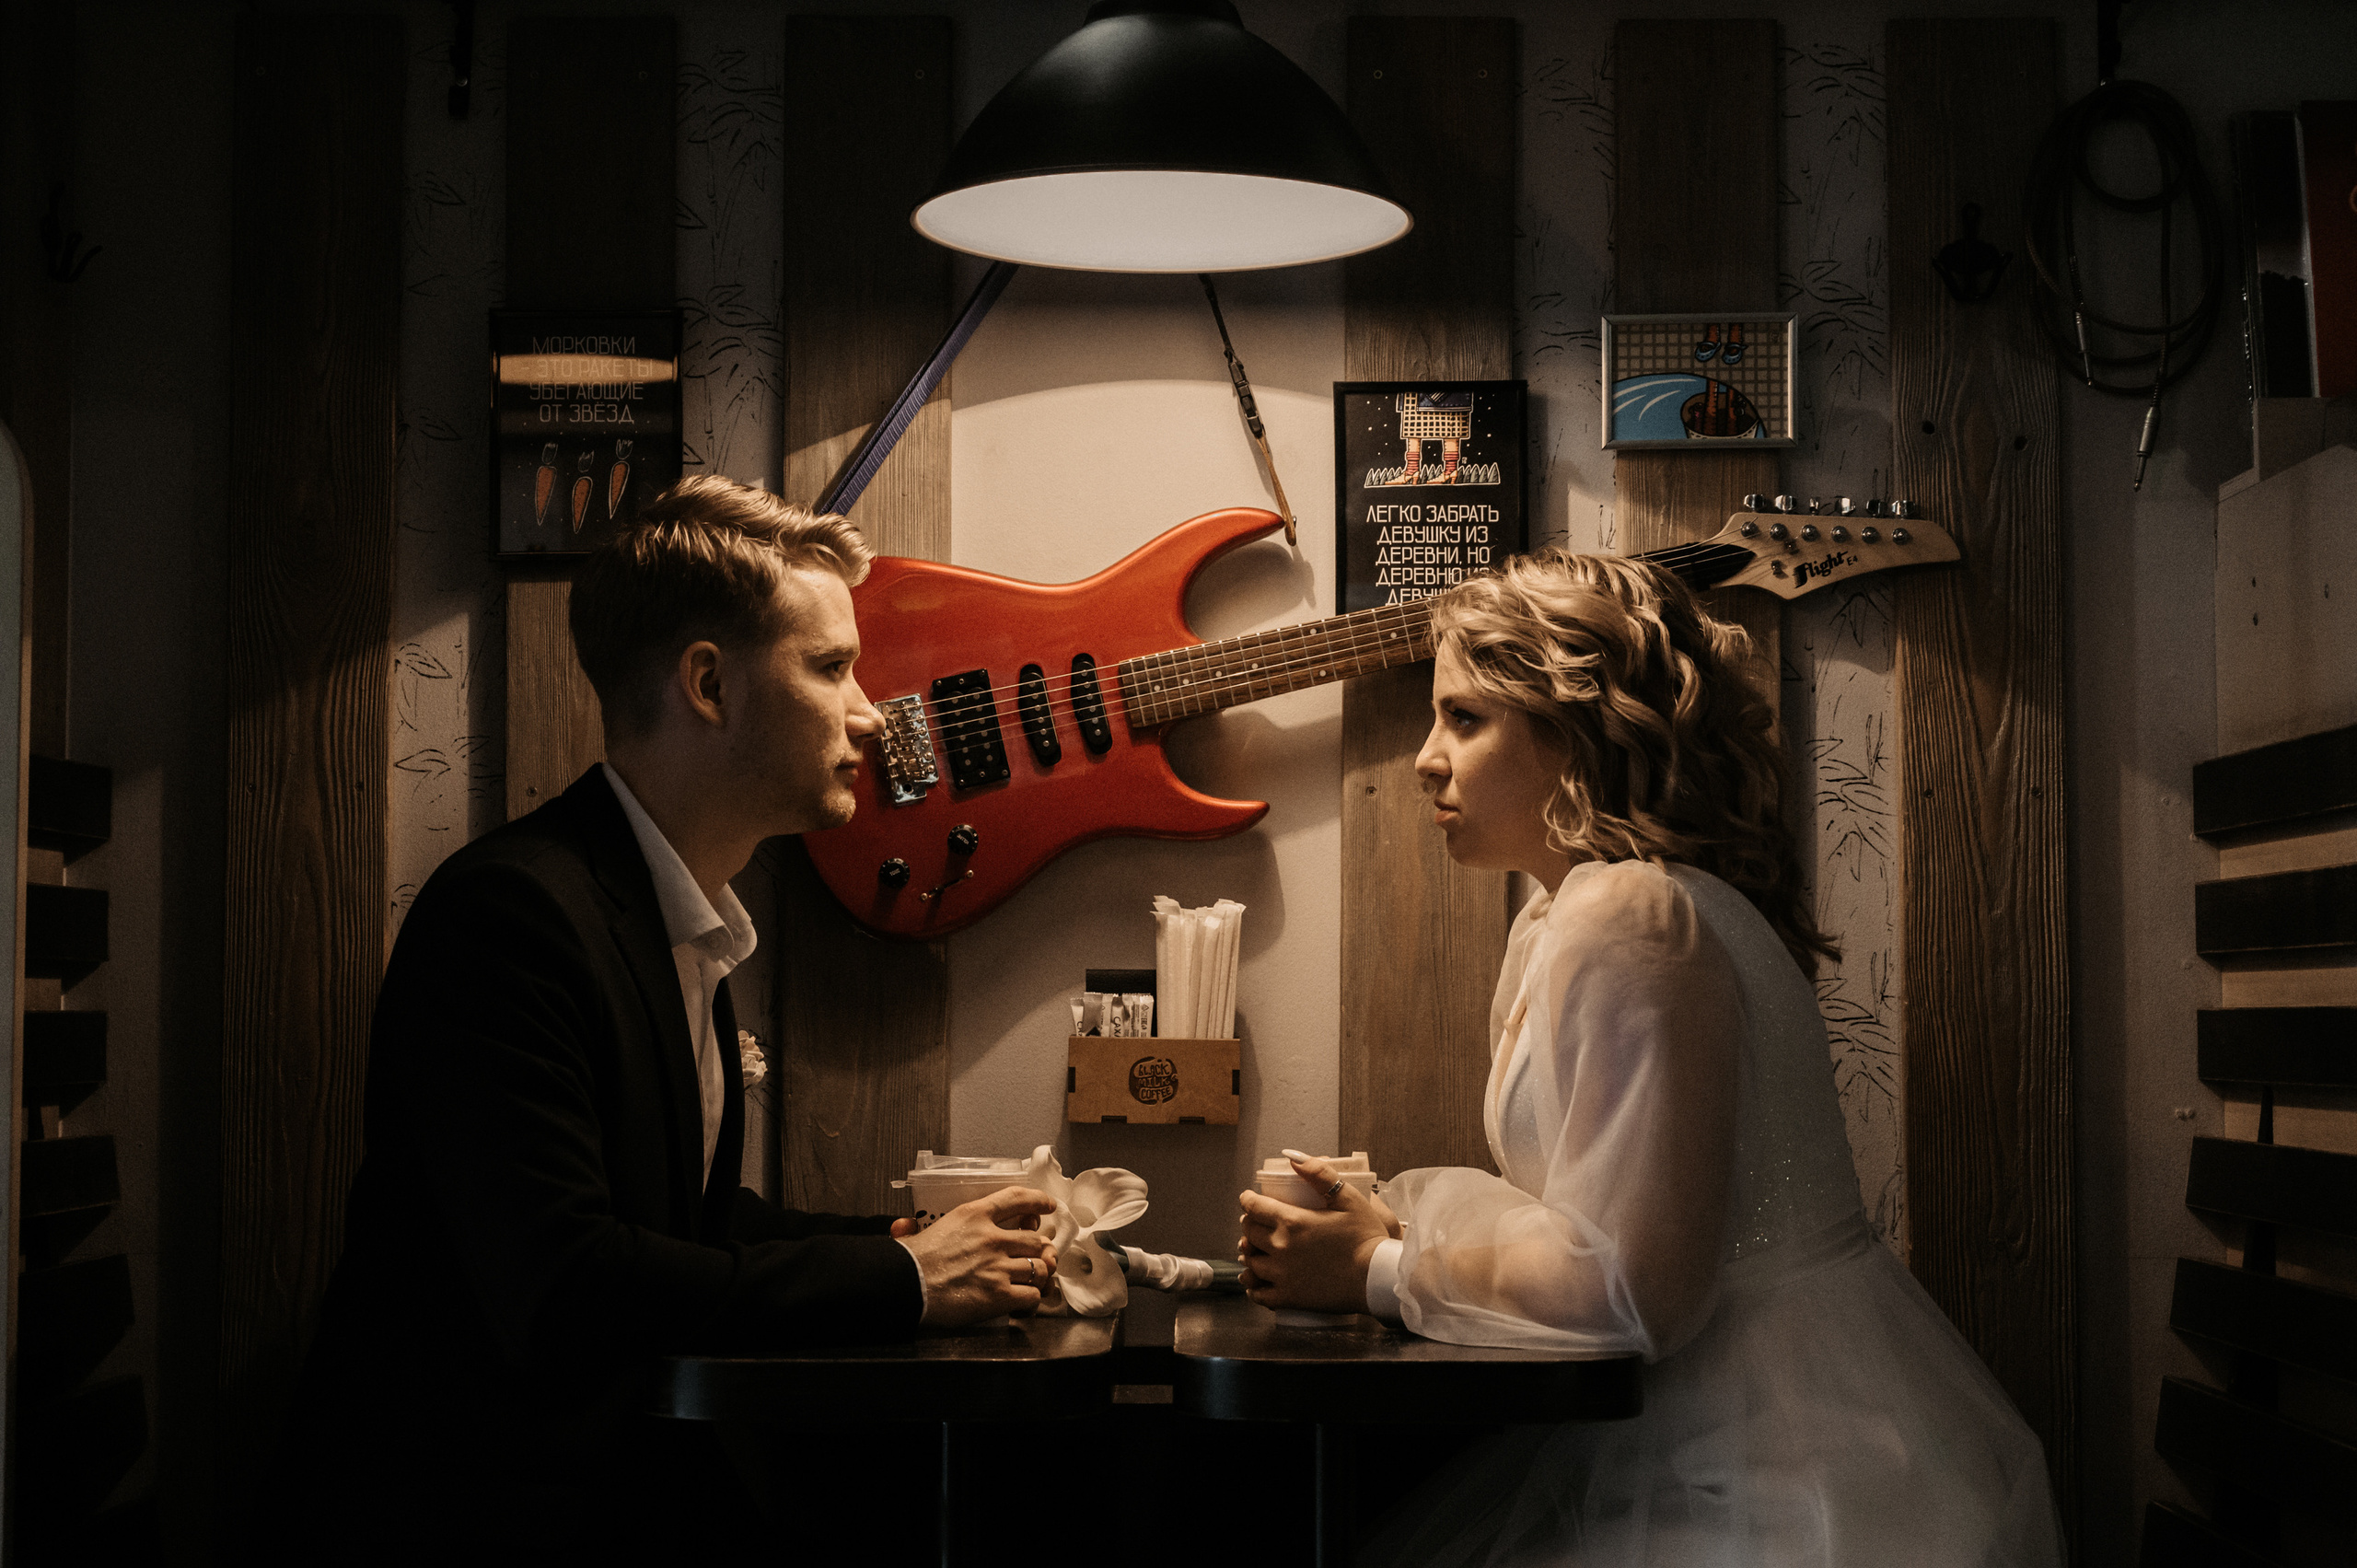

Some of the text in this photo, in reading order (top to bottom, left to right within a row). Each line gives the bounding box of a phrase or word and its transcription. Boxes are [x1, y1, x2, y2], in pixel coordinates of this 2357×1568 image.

[532, 336, 635, 354] МОРКОВКИ
[538, 359, 573, 377] ЭТО
[579, 358, 654, 378] РАКЕТЫ
[529, 381, 644, 402] УБЕГАЮЩИЕ
[540, 401, 635, 424] ОТ ЗВЁЗД
[1366, 505, 1500, 523] ЛЕГКО ЗАБРАТЬ
[1376, 526, 1489, 545] ДЕВУШКУ ИЗ
[1376, 546, 1491, 565] ДЕРЕВНИ, НО
[1376, 567, 1462, 587] ДЕРЕВНЮ
[1139, 1063, 1169, 1075] BLACK
[1138, 1075, 1170, 1087] MILK
[1141, 1086, 1172, 1100] COFFEE
